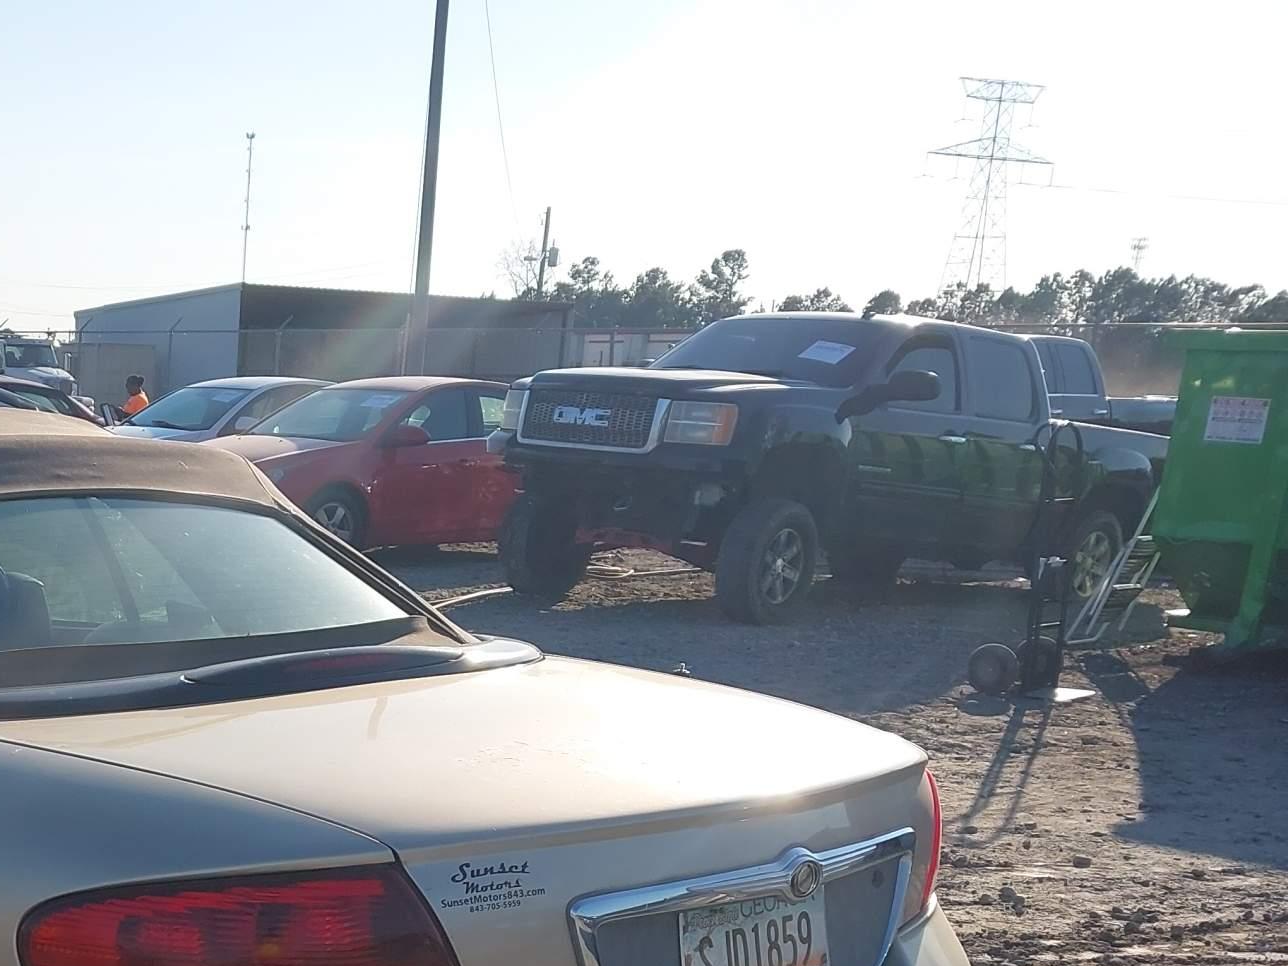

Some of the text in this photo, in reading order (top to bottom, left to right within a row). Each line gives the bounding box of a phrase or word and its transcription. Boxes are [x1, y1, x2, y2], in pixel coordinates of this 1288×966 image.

[554, 406, 611, 426] GMC
[451, 861, 530, 883] Sunset
[463, 879, 522, 894] Motors
[441, 888, 546, 909] SunsetMotors843.com
[469, 899, 521, 913] 843-705-5959
